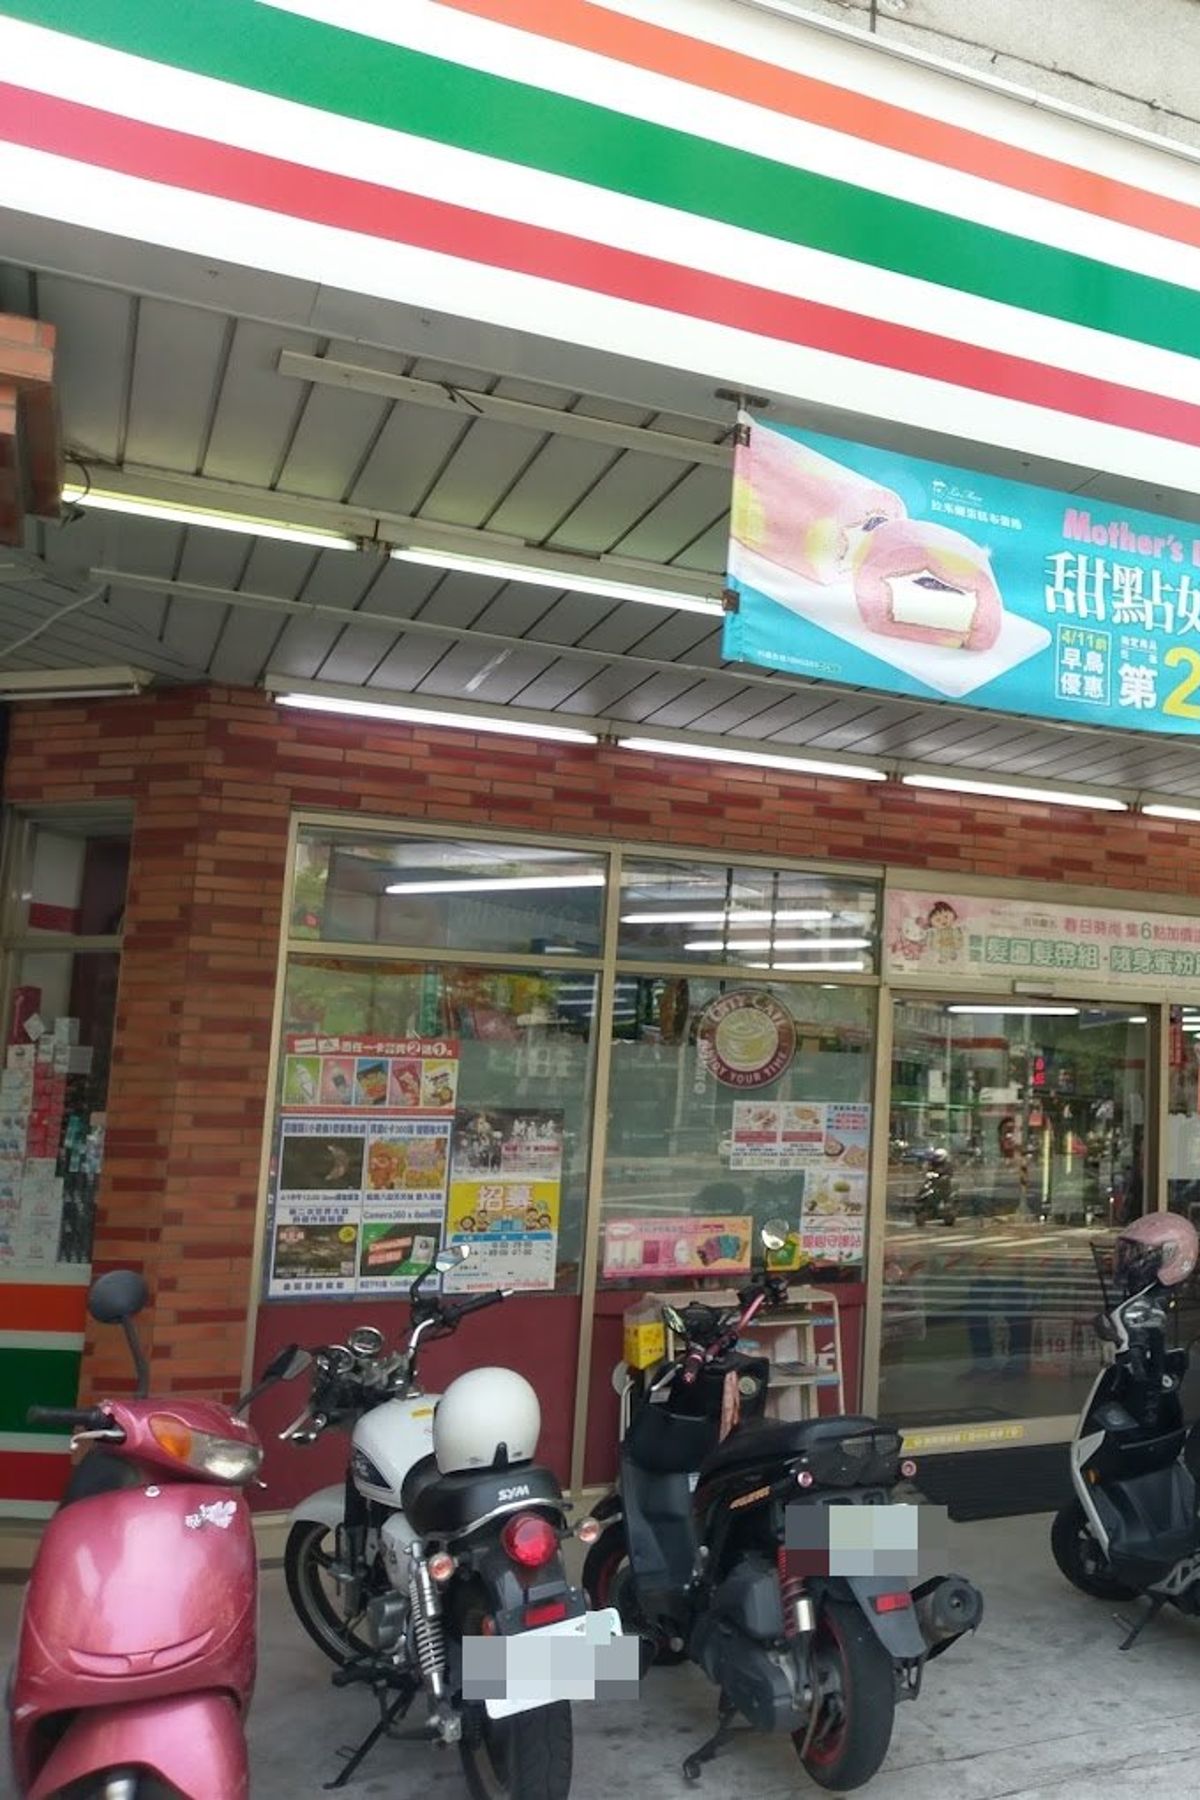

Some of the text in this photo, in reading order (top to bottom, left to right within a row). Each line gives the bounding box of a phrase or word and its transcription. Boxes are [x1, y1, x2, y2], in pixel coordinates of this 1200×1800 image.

[1062, 508, 1183, 564] Mother's
[1061, 647, 1105, 674] 早鳥
[1061, 671, 1105, 699] 優惠
[498, 1484, 530, 1501] SYM
